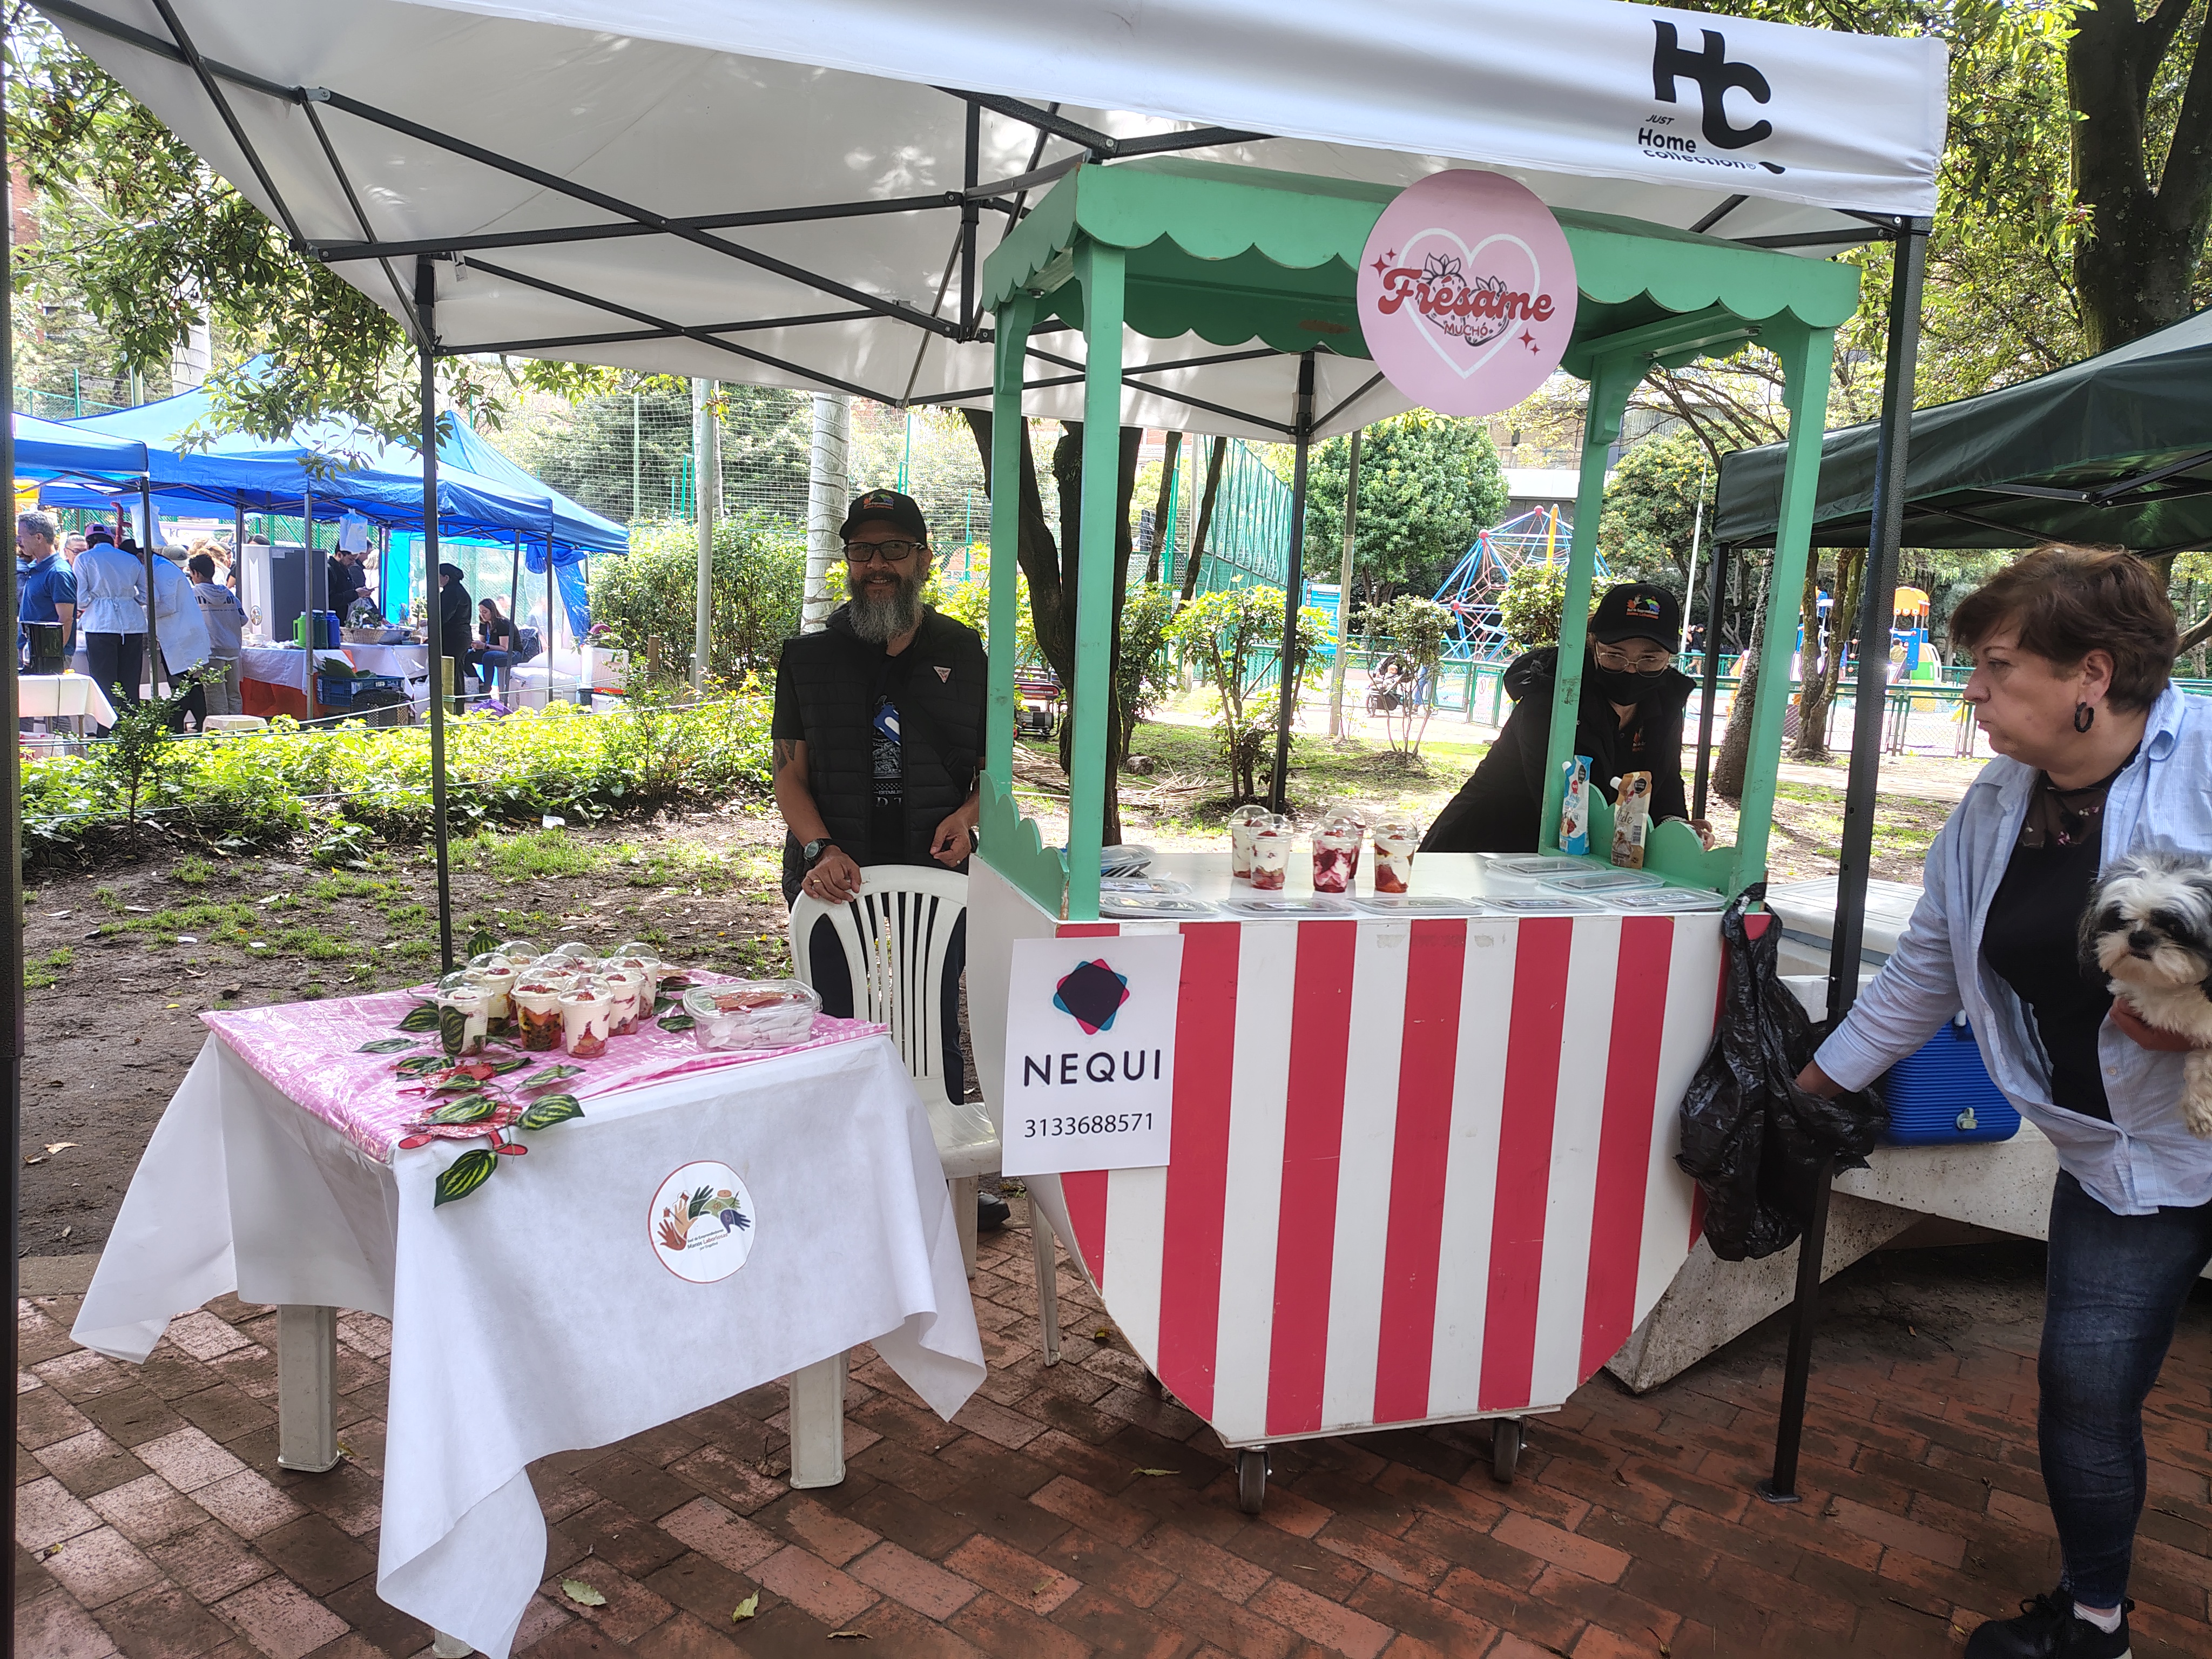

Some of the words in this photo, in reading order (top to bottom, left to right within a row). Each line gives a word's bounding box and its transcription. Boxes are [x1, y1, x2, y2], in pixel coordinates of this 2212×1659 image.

[1645, 114, 1675, 126] JUST
[1638, 127, 1696, 153] Home
[1444, 323, 1488, 336] MUCHO
[1023, 1049, 1161, 1087] NEQUI
[1024, 1112, 1152, 1137] 3133688571
